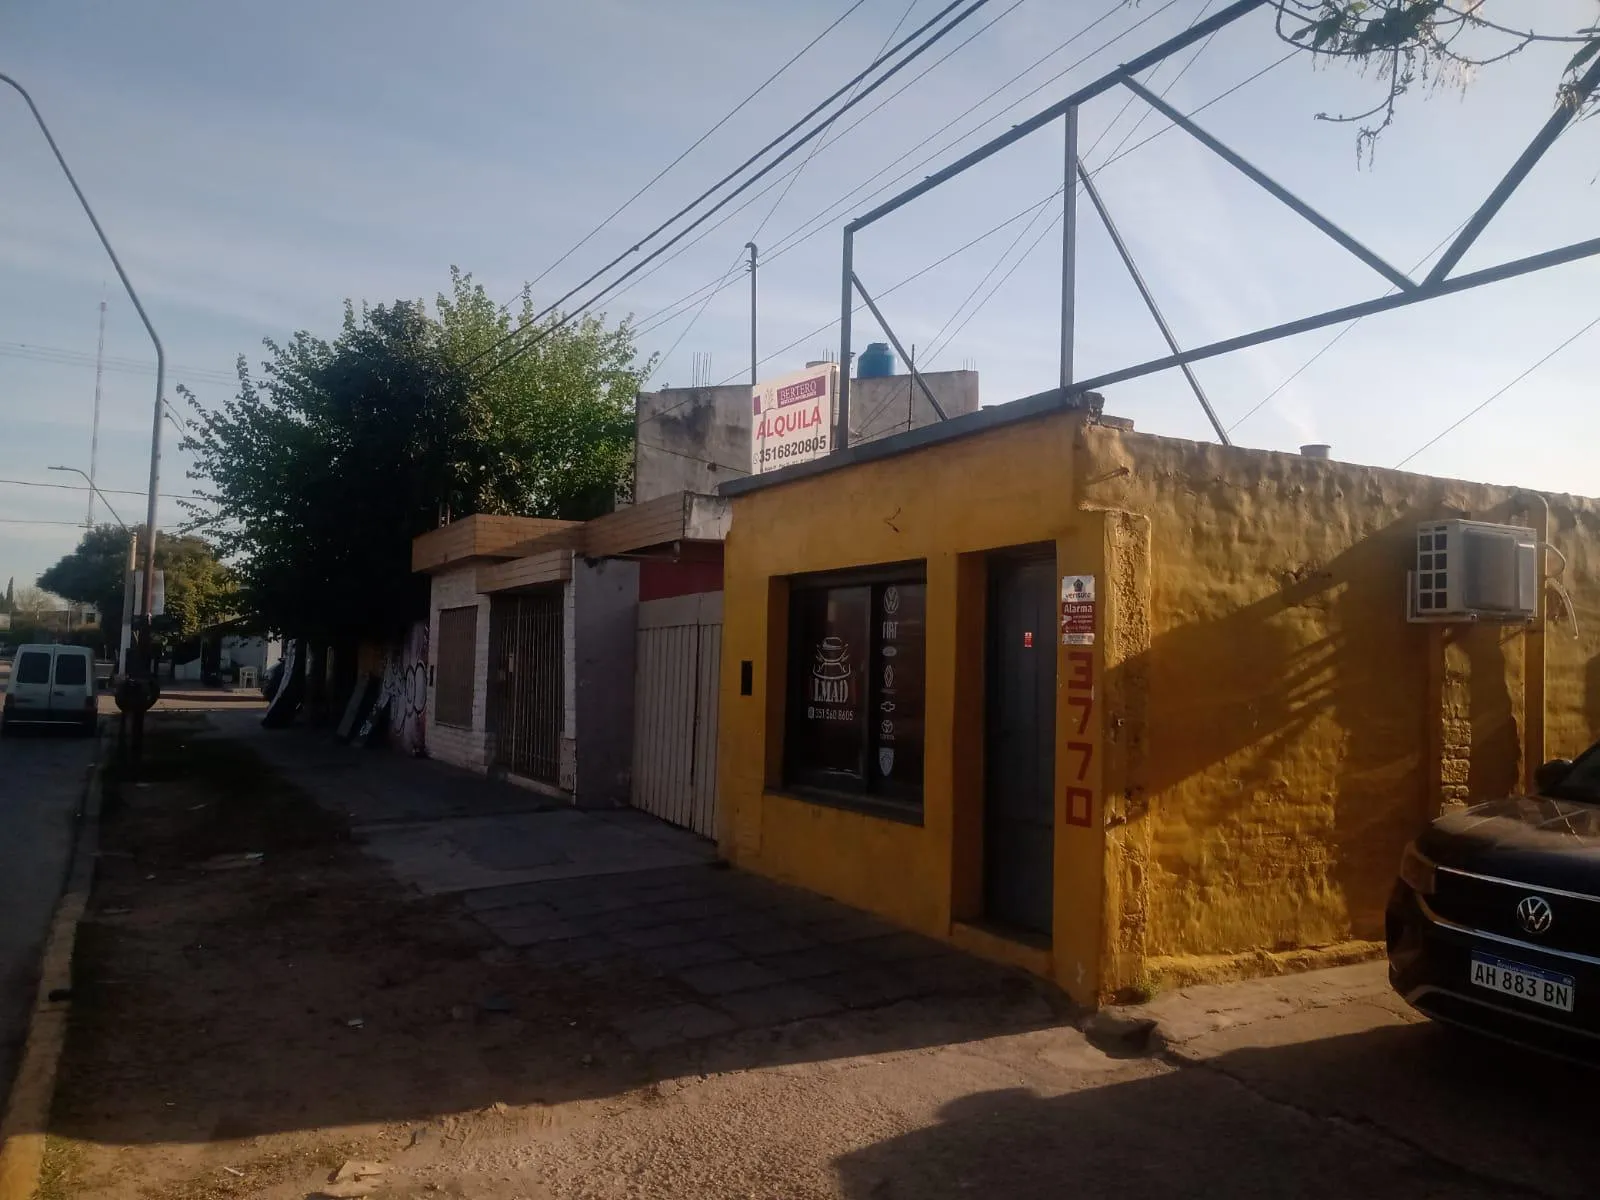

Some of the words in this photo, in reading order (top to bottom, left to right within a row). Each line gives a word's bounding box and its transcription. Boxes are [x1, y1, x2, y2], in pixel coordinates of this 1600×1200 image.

[781, 381, 817, 400] BERTERO
[757, 406, 822, 440] ALQUILA
[759, 435, 826, 463] 3516820805
[1064, 604, 1092, 613] Alarma
[1066, 651, 1094, 828] 3770
[1475, 964, 1496, 986] AH
[1502, 971, 1537, 997] 883
[1544, 982, 1568, 1007] BN
